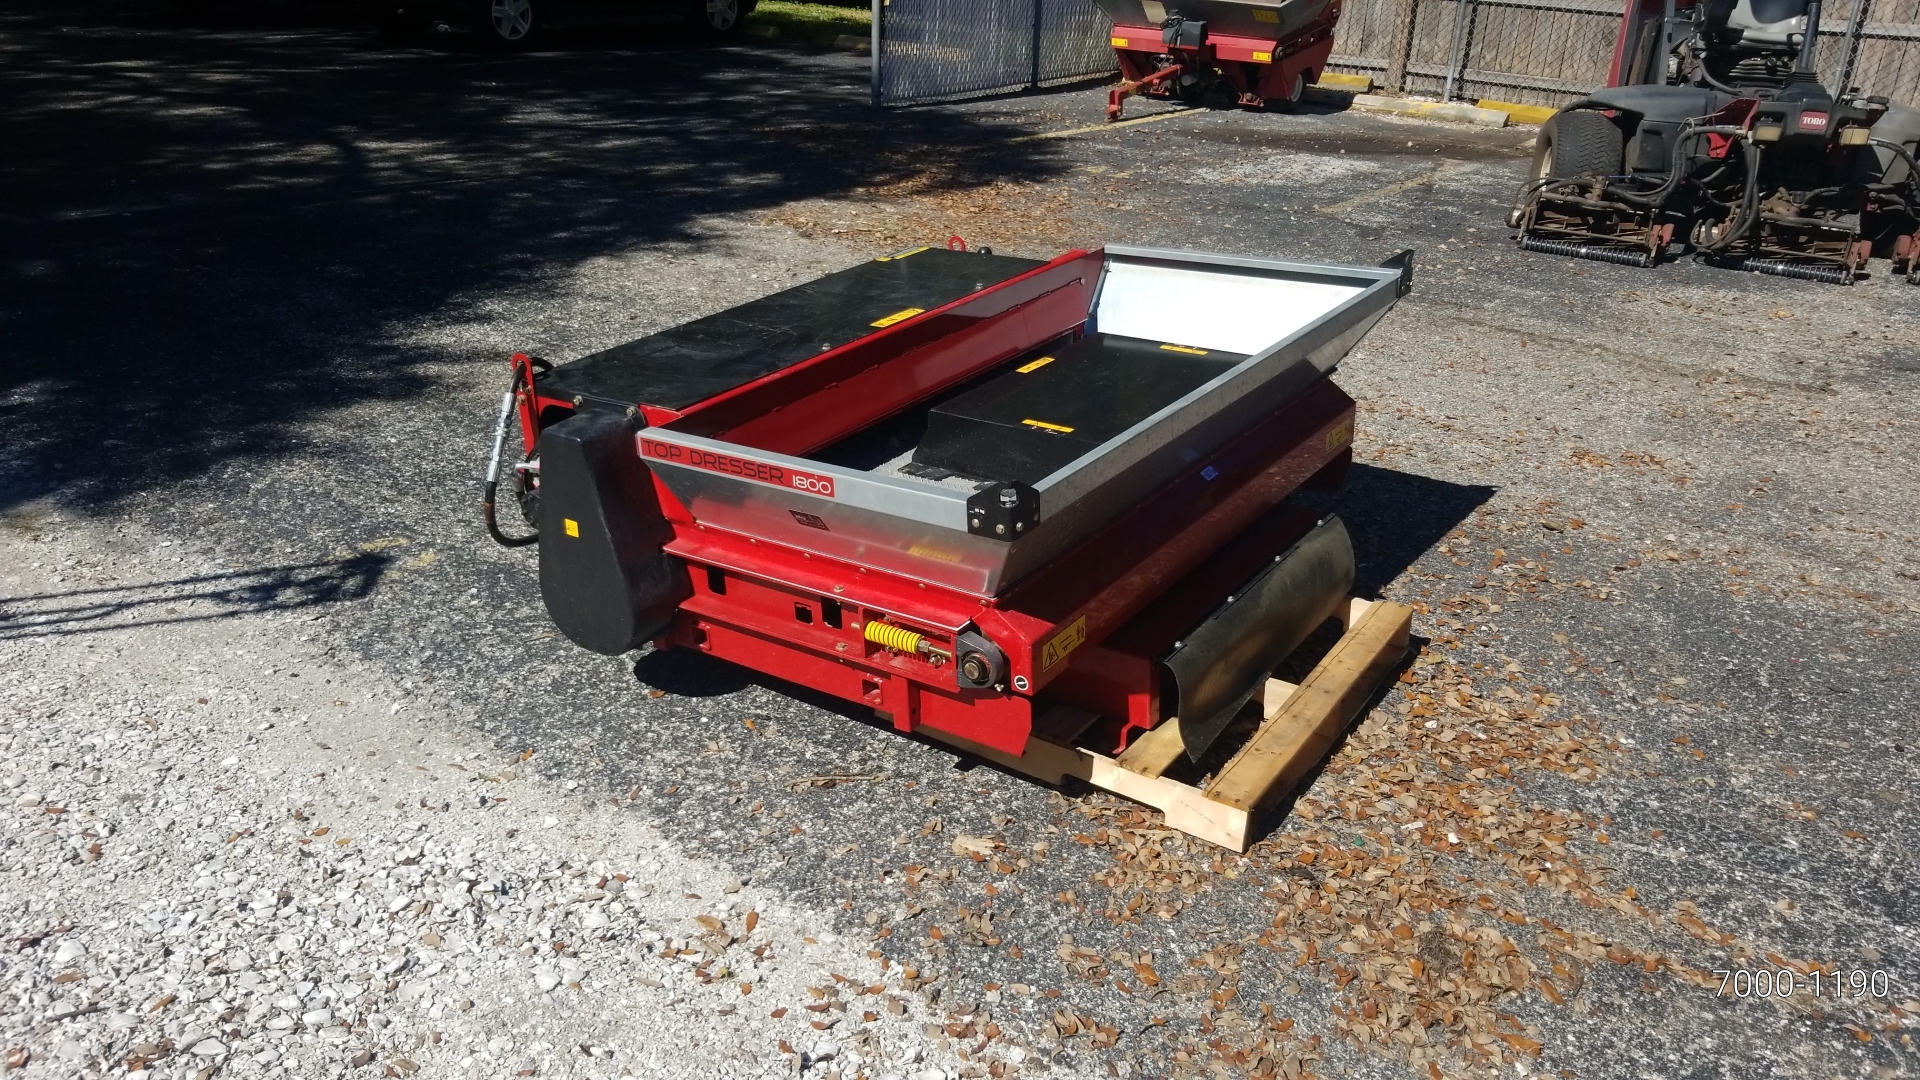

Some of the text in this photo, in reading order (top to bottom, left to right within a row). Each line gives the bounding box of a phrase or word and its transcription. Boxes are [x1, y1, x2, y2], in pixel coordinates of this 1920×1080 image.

[1802, 116, 1826, 126] TORO
[643, 440, 832, 494] TOP DRESSER 1800
